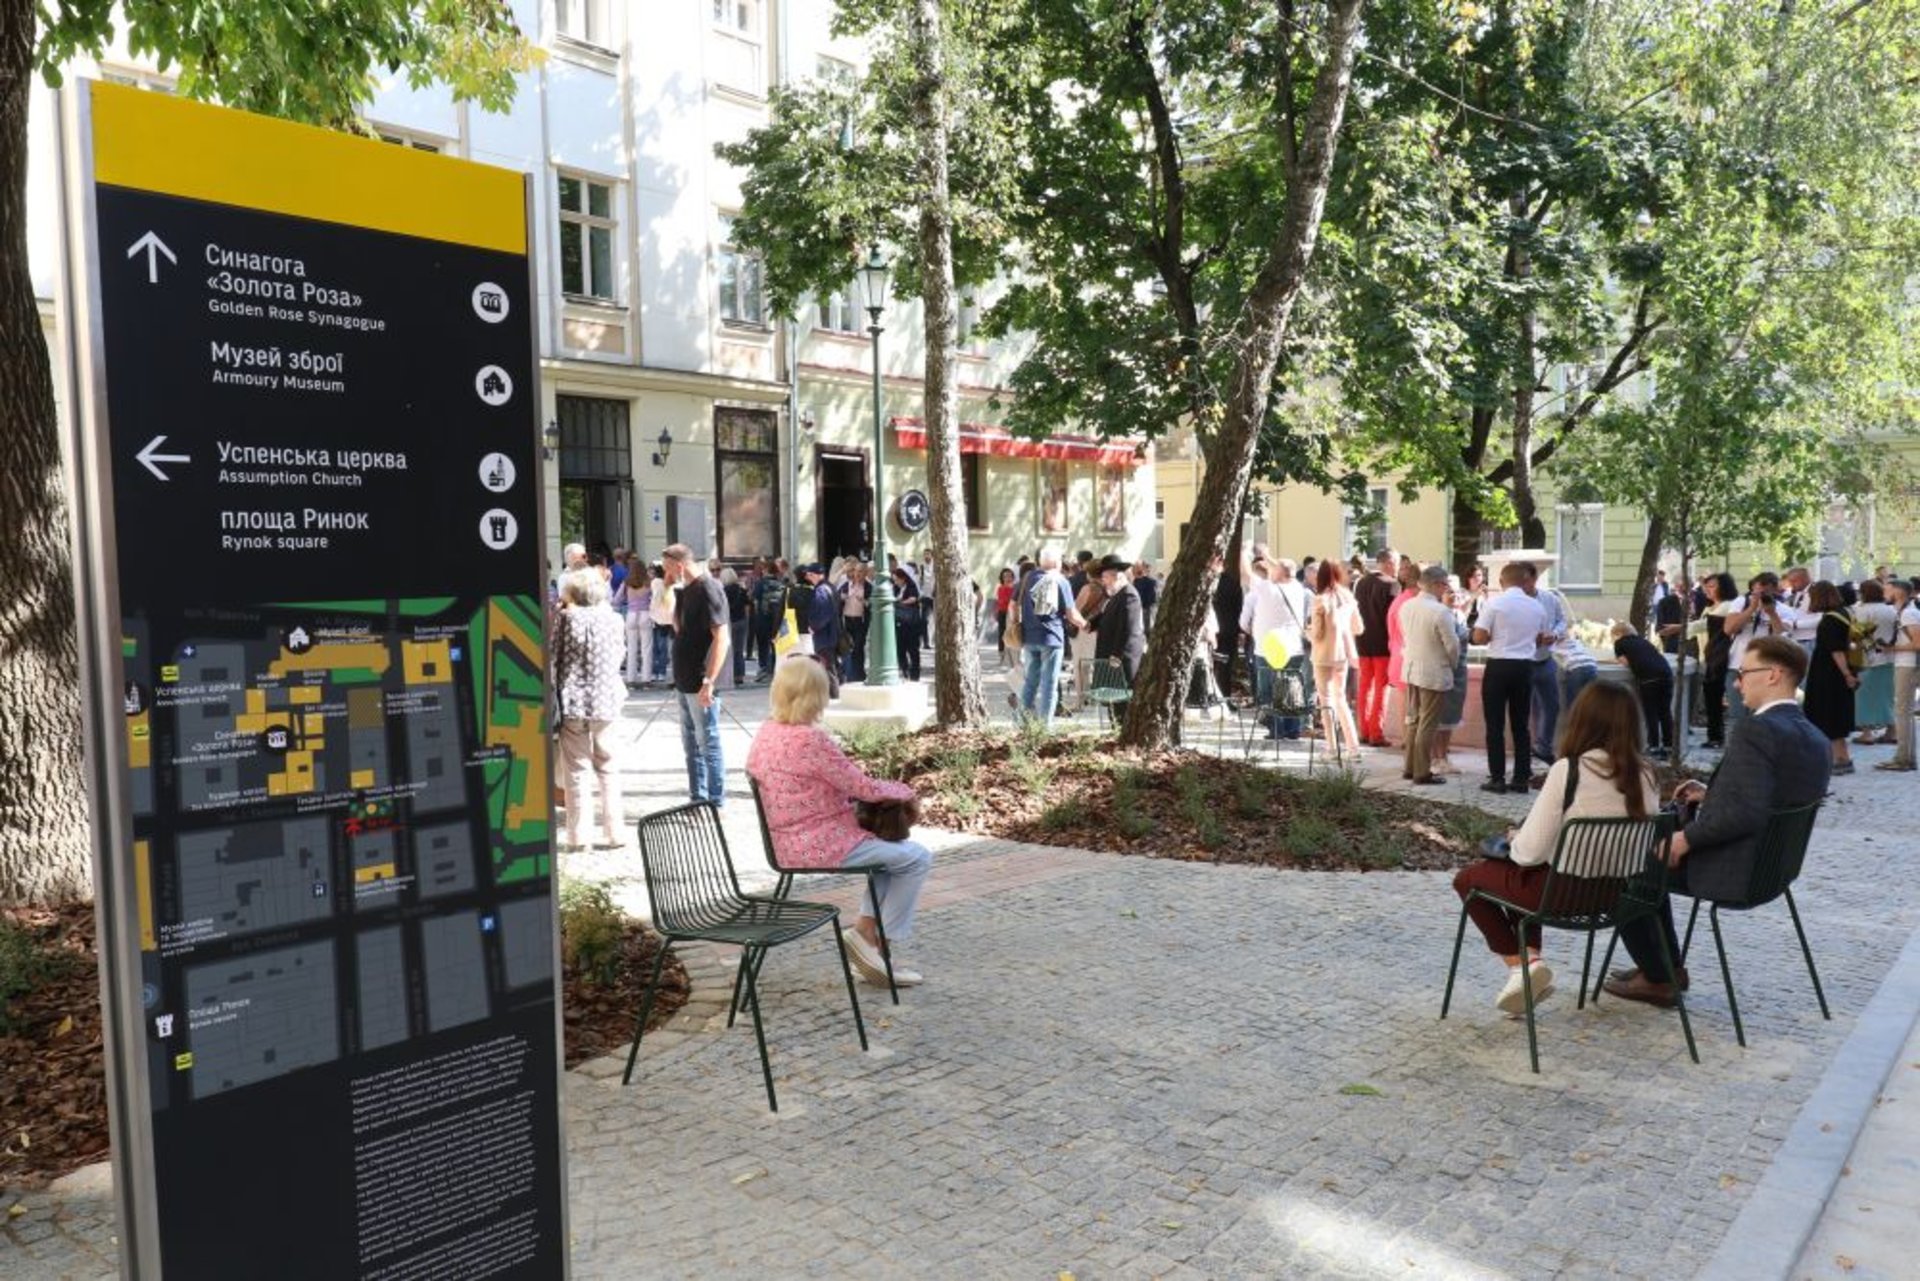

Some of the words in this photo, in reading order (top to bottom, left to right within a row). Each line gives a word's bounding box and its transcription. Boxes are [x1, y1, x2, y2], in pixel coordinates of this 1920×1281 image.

[206, 243, 306, 277] Синагога
[207, 271, 296, 300] «Золота
[303, 281, 362, 307] Роза»
[208, 299, 263, 317] Golden
[268, 305, 304, 321] Rose
[308, 310, 385, 331] Synagogue
[211, 341, 282, 368] Музей
[288, 349, 344, 375] зброї
[212, 369, 279, 390] Armoury
[283, 375, 345, 392] Museum
[216, 441, 331, 466] Успенська
[337, 450, 408, 471] церква
[219, 469, 308, 486] Assumption
[312, 471, 362, 486] Church
[221, 511, 297, 532] площа
[303, 508, 370, 530] Ринок
[222, 535, 272, 551] Rynok
[277, 536, 329, 551] square
